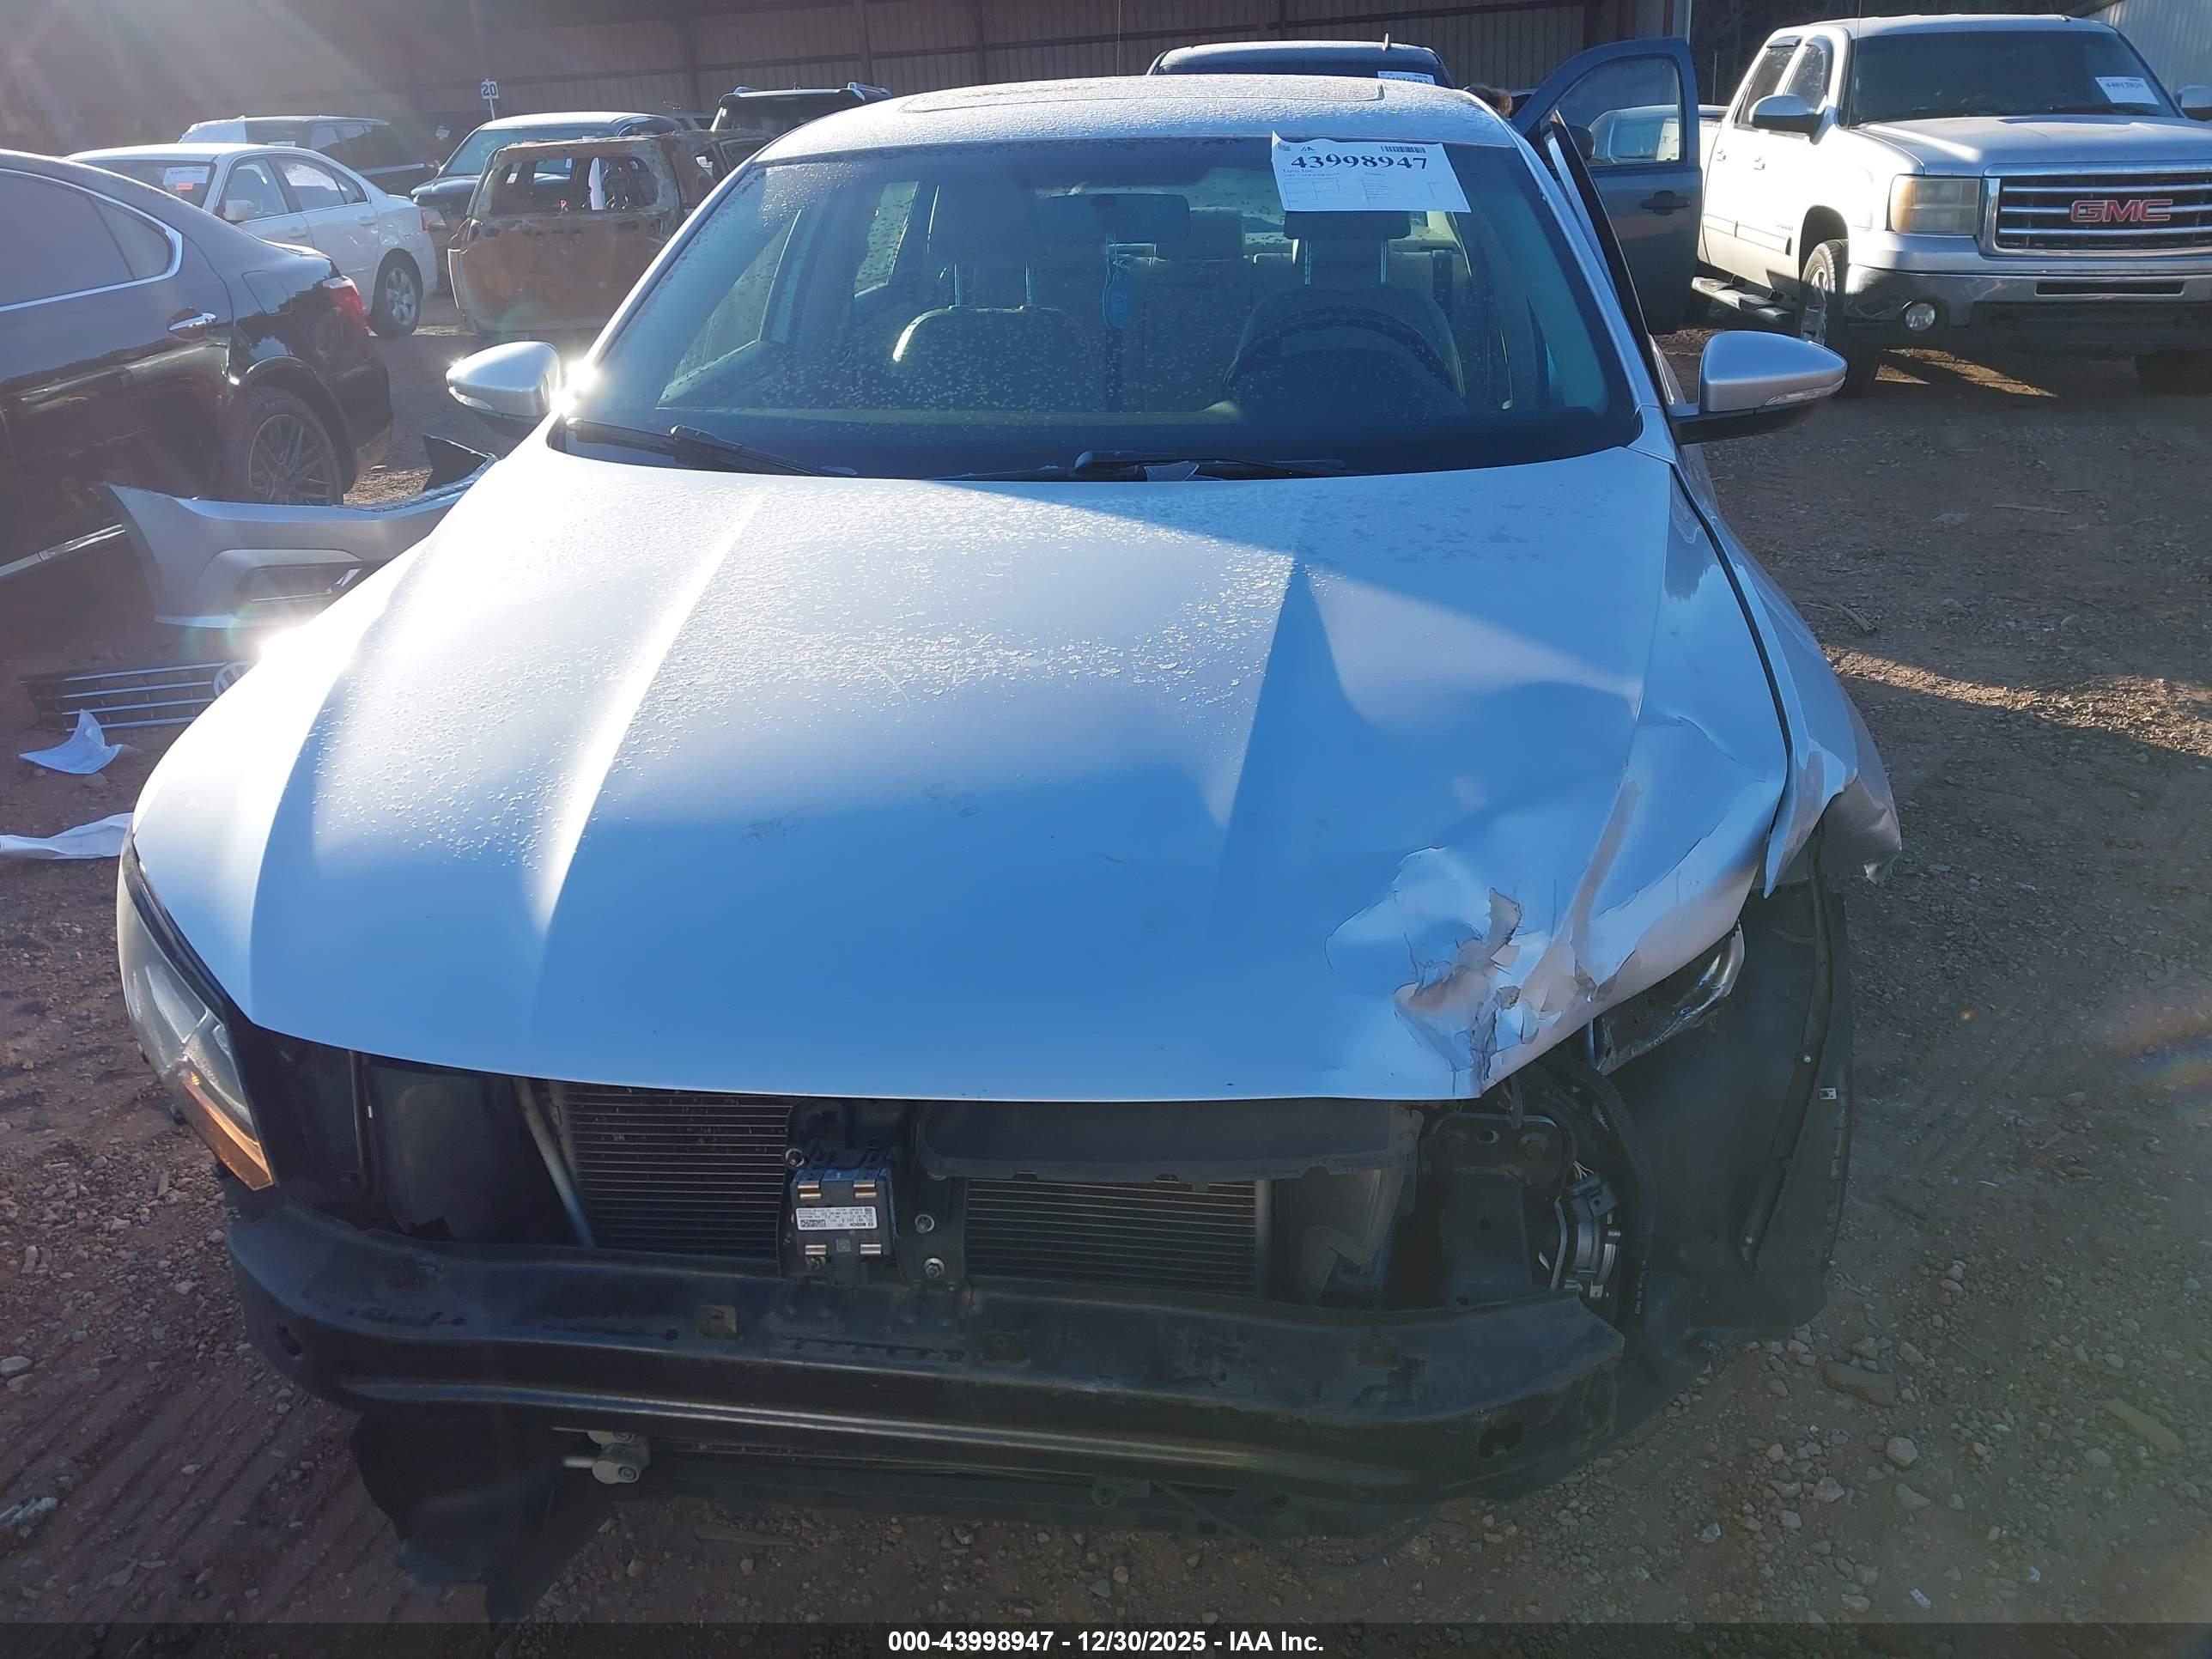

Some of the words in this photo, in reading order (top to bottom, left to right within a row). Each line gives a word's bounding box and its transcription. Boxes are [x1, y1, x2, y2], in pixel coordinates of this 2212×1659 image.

[482, 84, 496, 96] 20
[1291, 154, 1427, 169] 43998947
[2070, 199, 2172, 222] GMC
